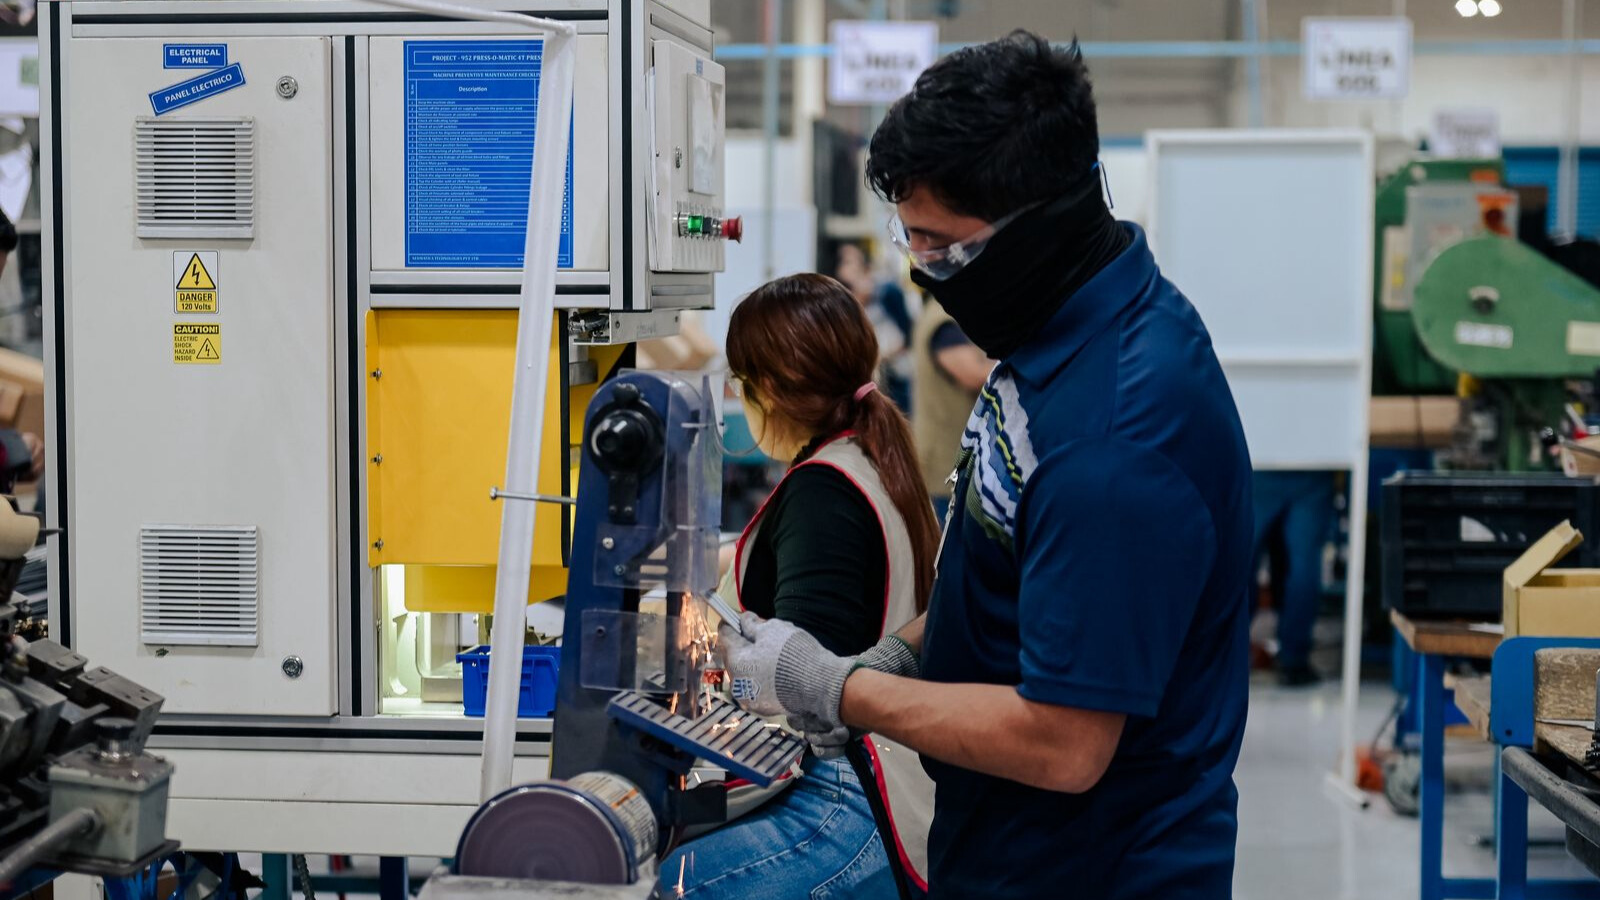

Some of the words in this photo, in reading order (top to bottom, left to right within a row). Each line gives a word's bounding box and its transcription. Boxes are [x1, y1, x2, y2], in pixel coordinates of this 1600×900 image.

[164, 89, 191, 104] PANEL
[191, 73, 232, 94] ELECTRICO
[180, 293, 213, 302] DANGER
